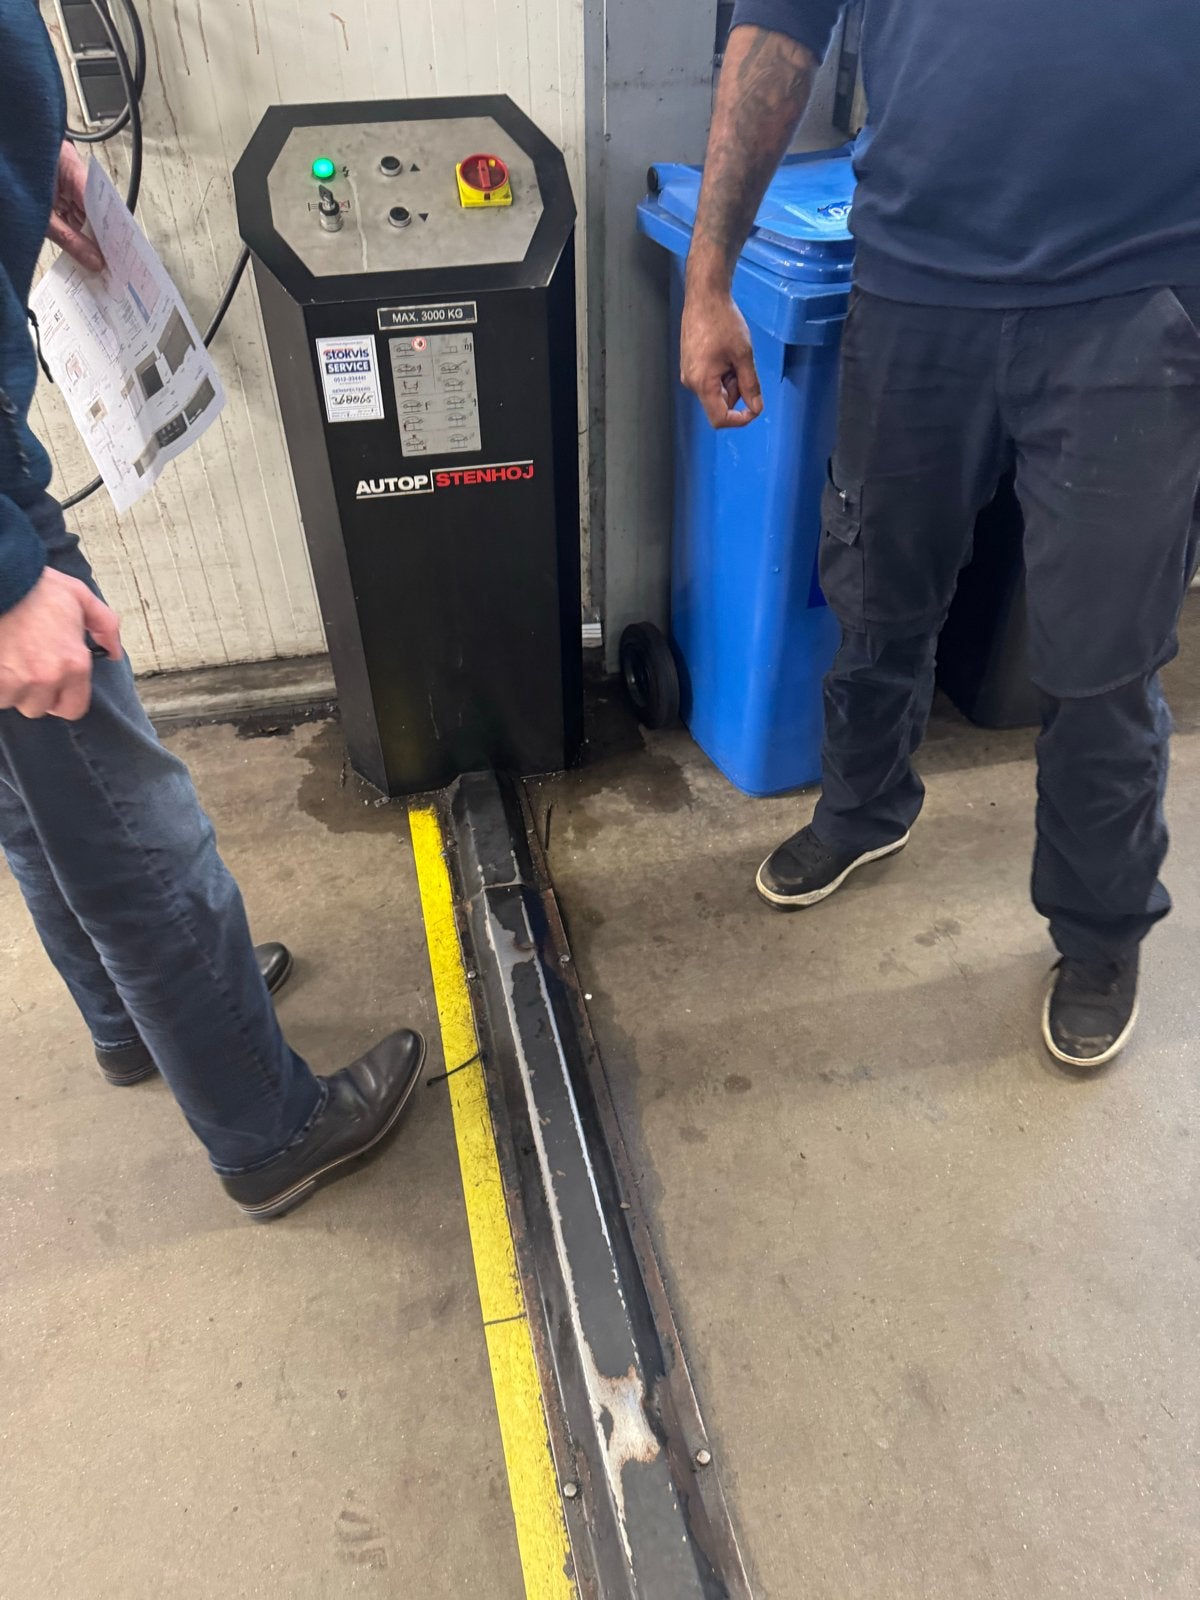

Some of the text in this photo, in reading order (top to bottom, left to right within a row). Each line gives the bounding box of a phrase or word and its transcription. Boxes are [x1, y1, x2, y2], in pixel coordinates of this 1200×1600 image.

[392, 308, 463, 323] MAX. 3000 KG
[327, 361, 369, 373] SERVICE
[356, 465, 534, 495] AUTOP STENHOJ
